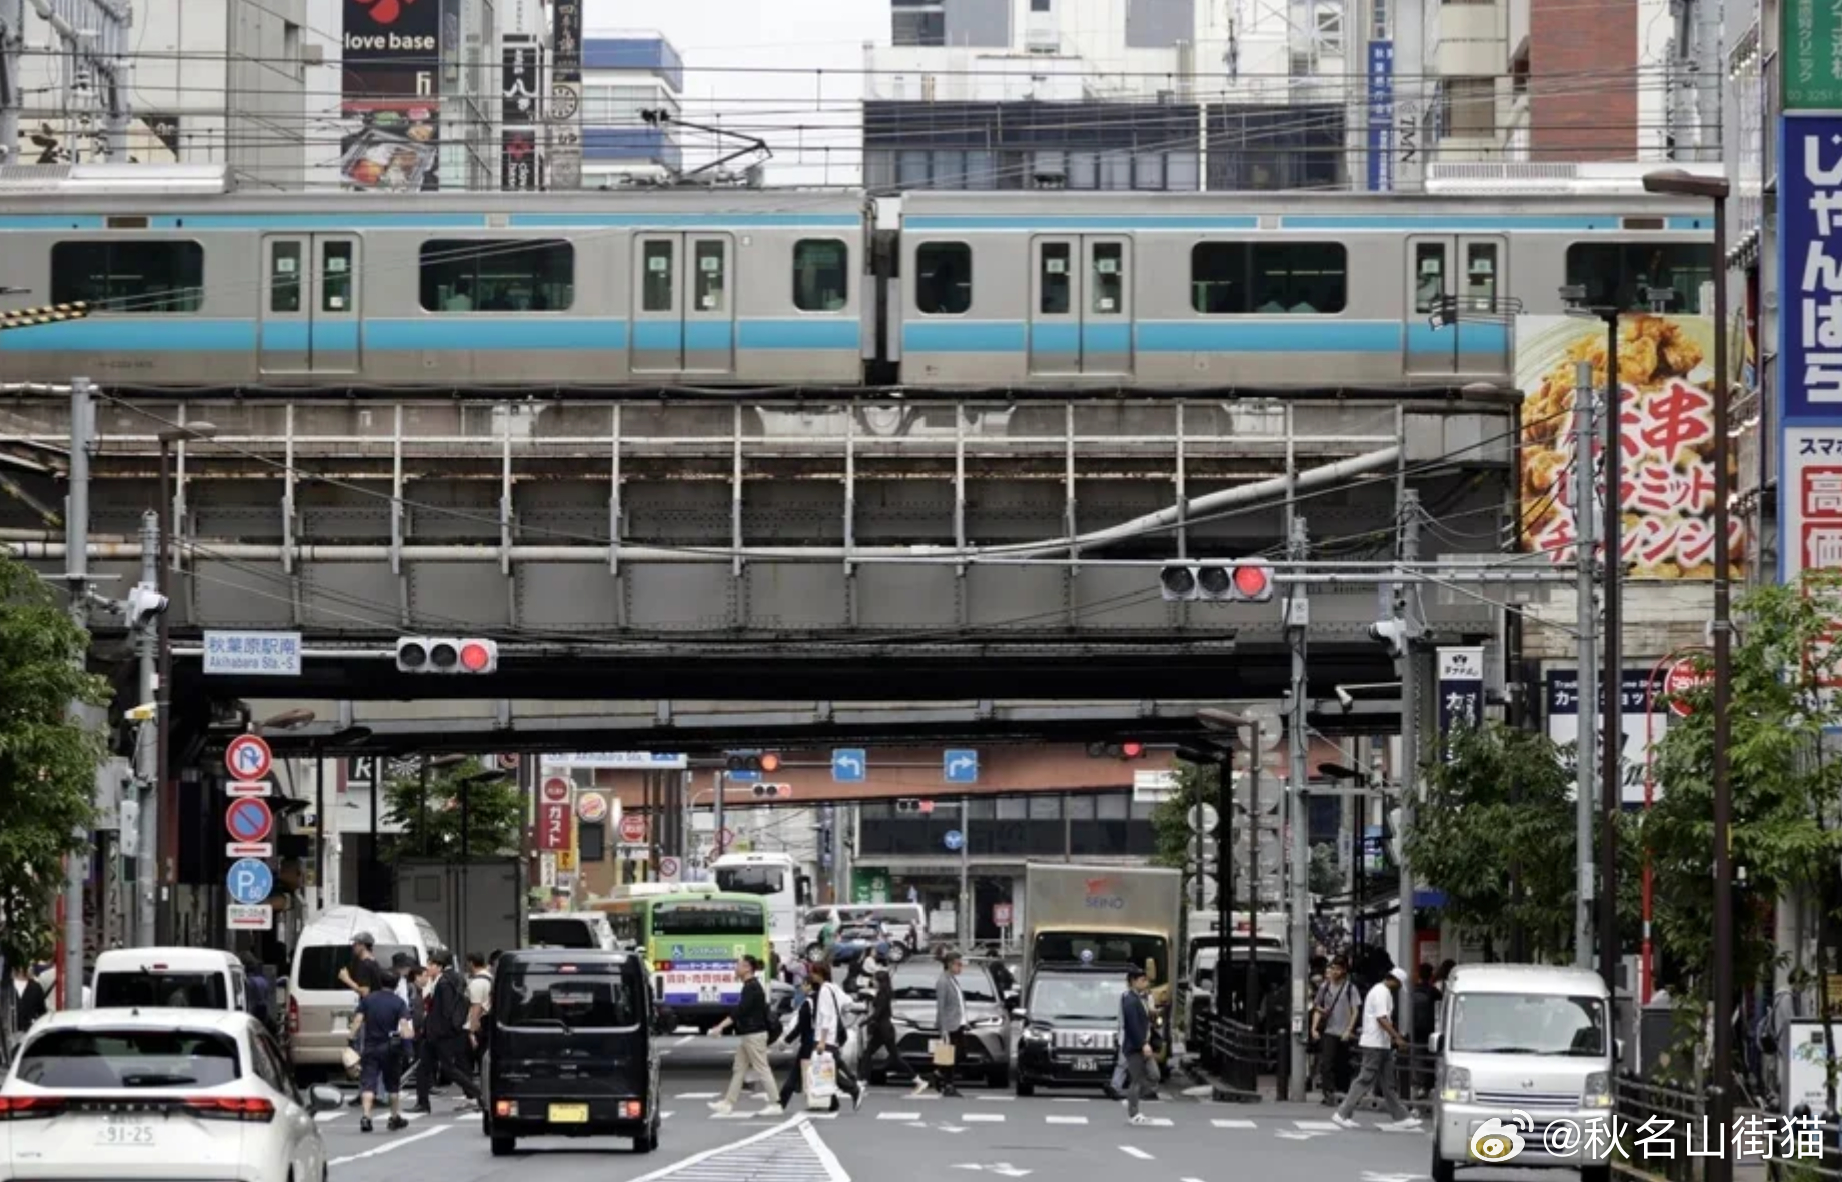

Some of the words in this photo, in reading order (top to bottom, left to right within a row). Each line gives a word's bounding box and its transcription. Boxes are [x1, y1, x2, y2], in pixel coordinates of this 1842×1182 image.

[341, 32, 386, 50] love
[388, 32, 435, 50] base
[208, 637, 295, 655] 秋葉原駅南
[210, 656, 259, 669] Akihabara
[549, 806, 562, 847] ガスト
[1085, 896, 1125, 910] SEINO
[81, 1103, 168, 1112] NISSAN
[107, 1126, 153, 1142] 91-25
